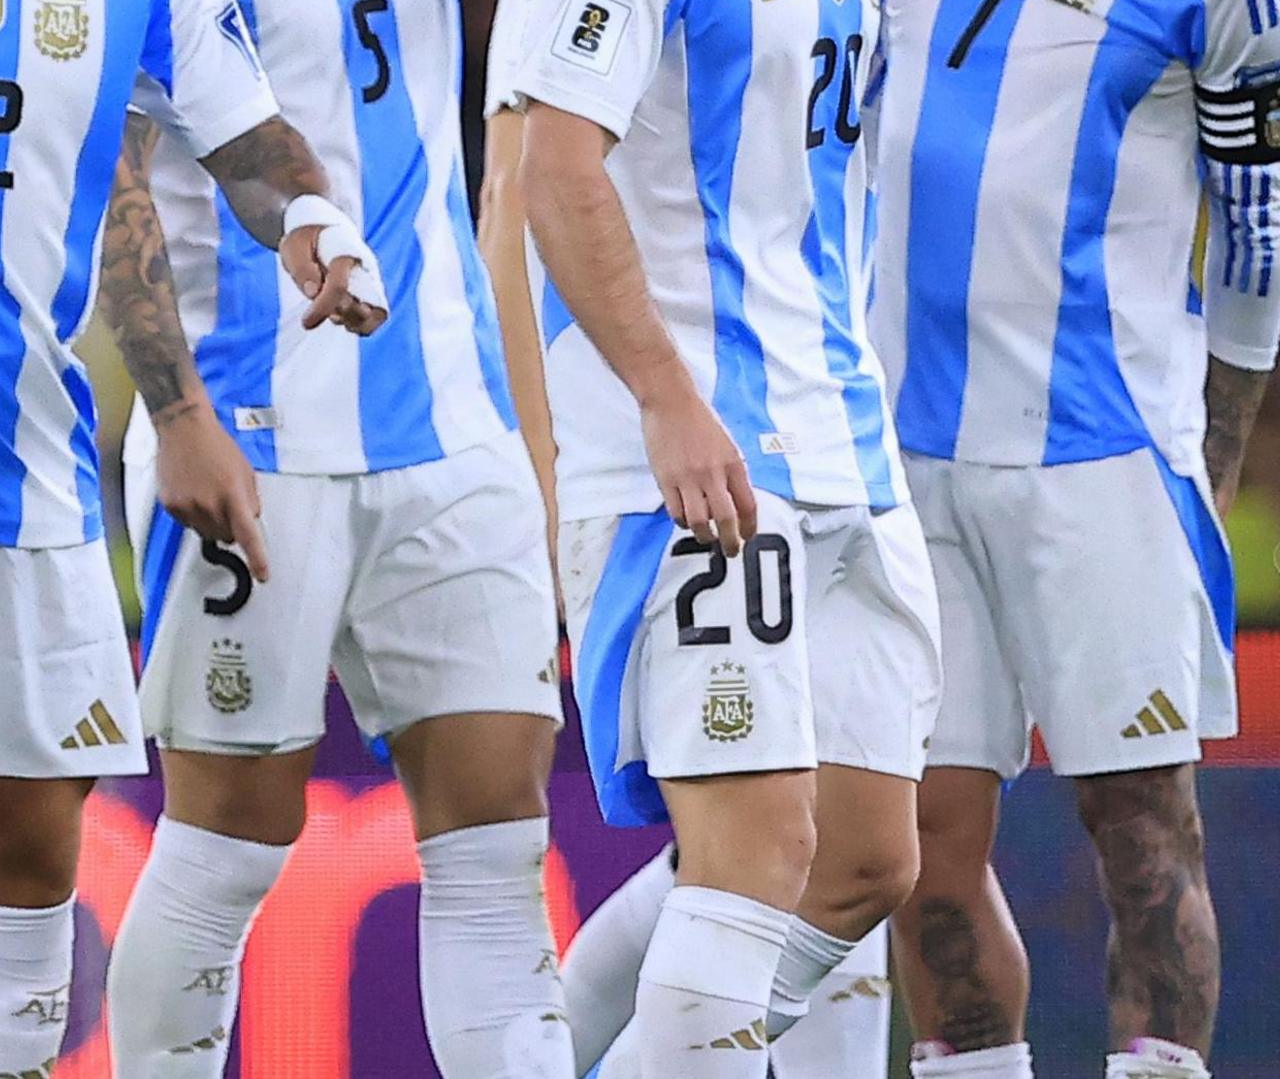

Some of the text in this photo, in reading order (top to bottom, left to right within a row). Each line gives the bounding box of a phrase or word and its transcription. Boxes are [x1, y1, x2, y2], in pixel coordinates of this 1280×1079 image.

[806, 33, 863, 152] 20
[201, 534, 253, 617] 5
[671, 533, 793, 646] 20
[712, 696, 744, 726] AFA
